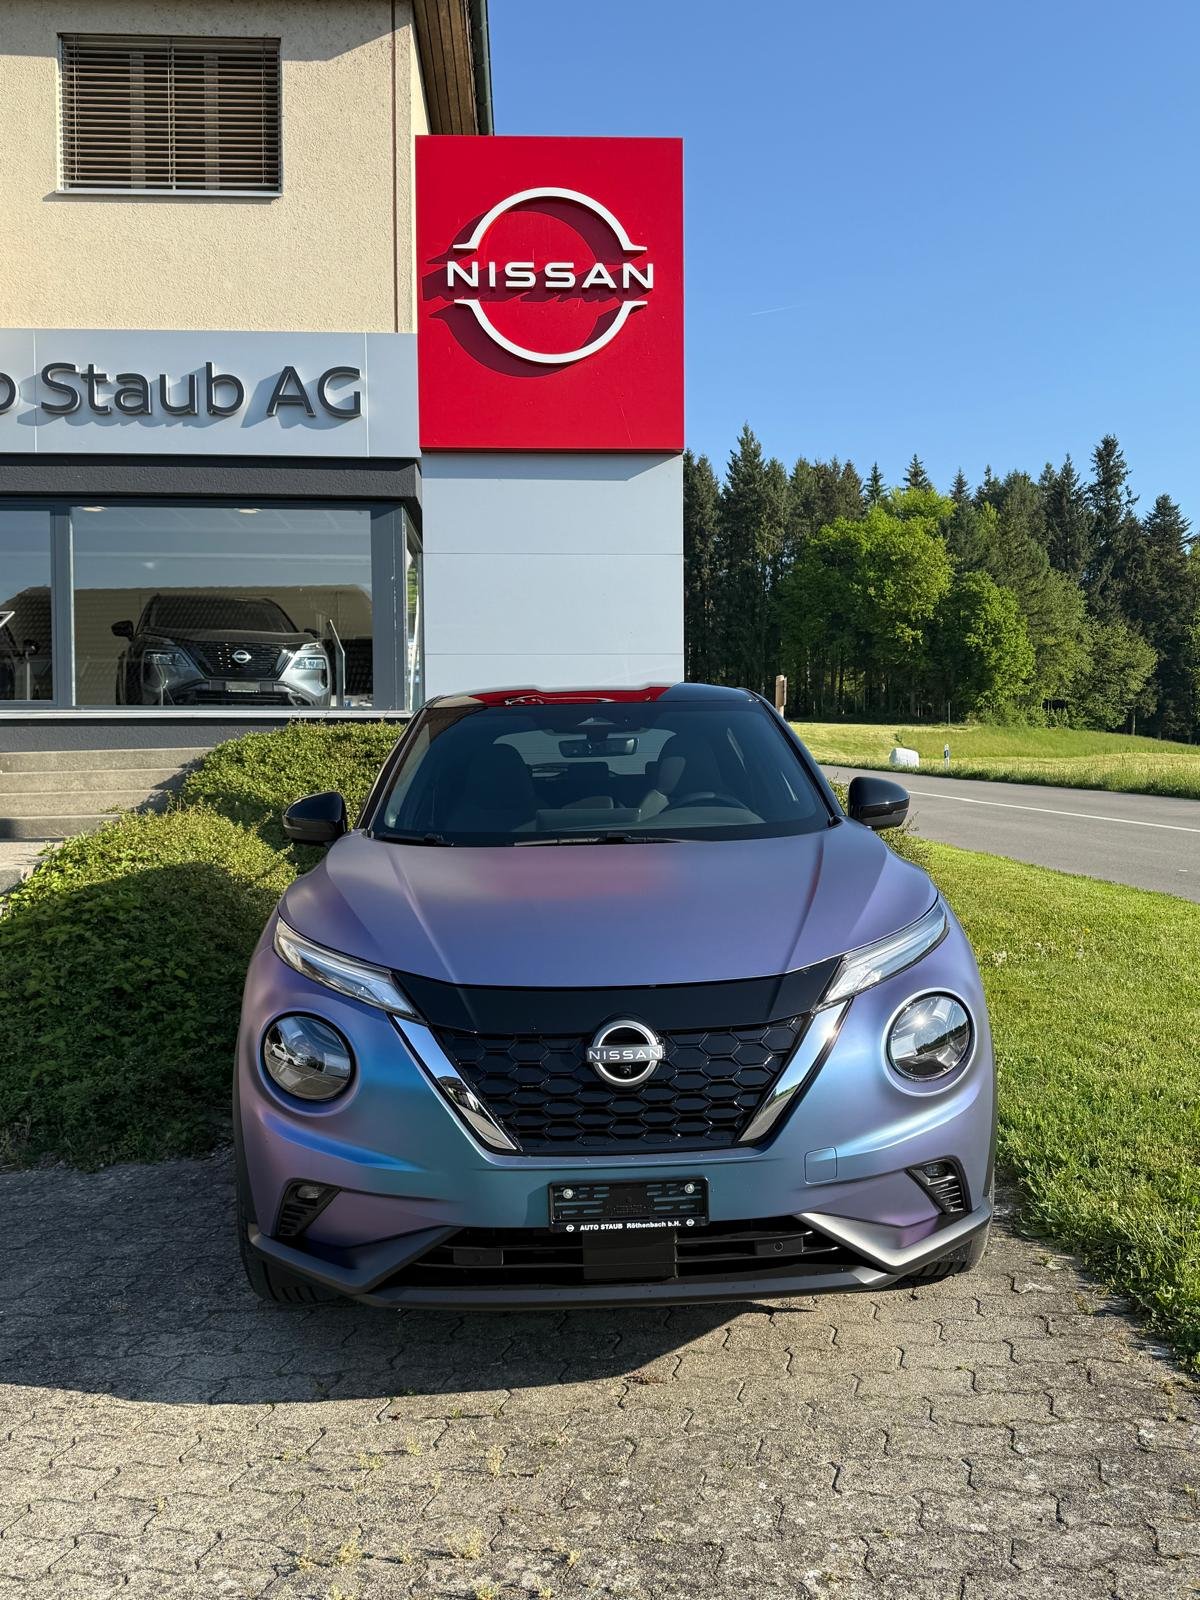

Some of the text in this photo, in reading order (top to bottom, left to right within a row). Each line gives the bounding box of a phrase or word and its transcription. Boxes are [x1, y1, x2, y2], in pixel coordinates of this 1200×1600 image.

[446, 260, 655, 290] NISSAN
[40, 361, 247, 416] Staub
[265, 365, 363, 419] AG
[588, 1048, 661, 1061] NISSAN
[626, 1221, 667, 1229] Röthenbach
